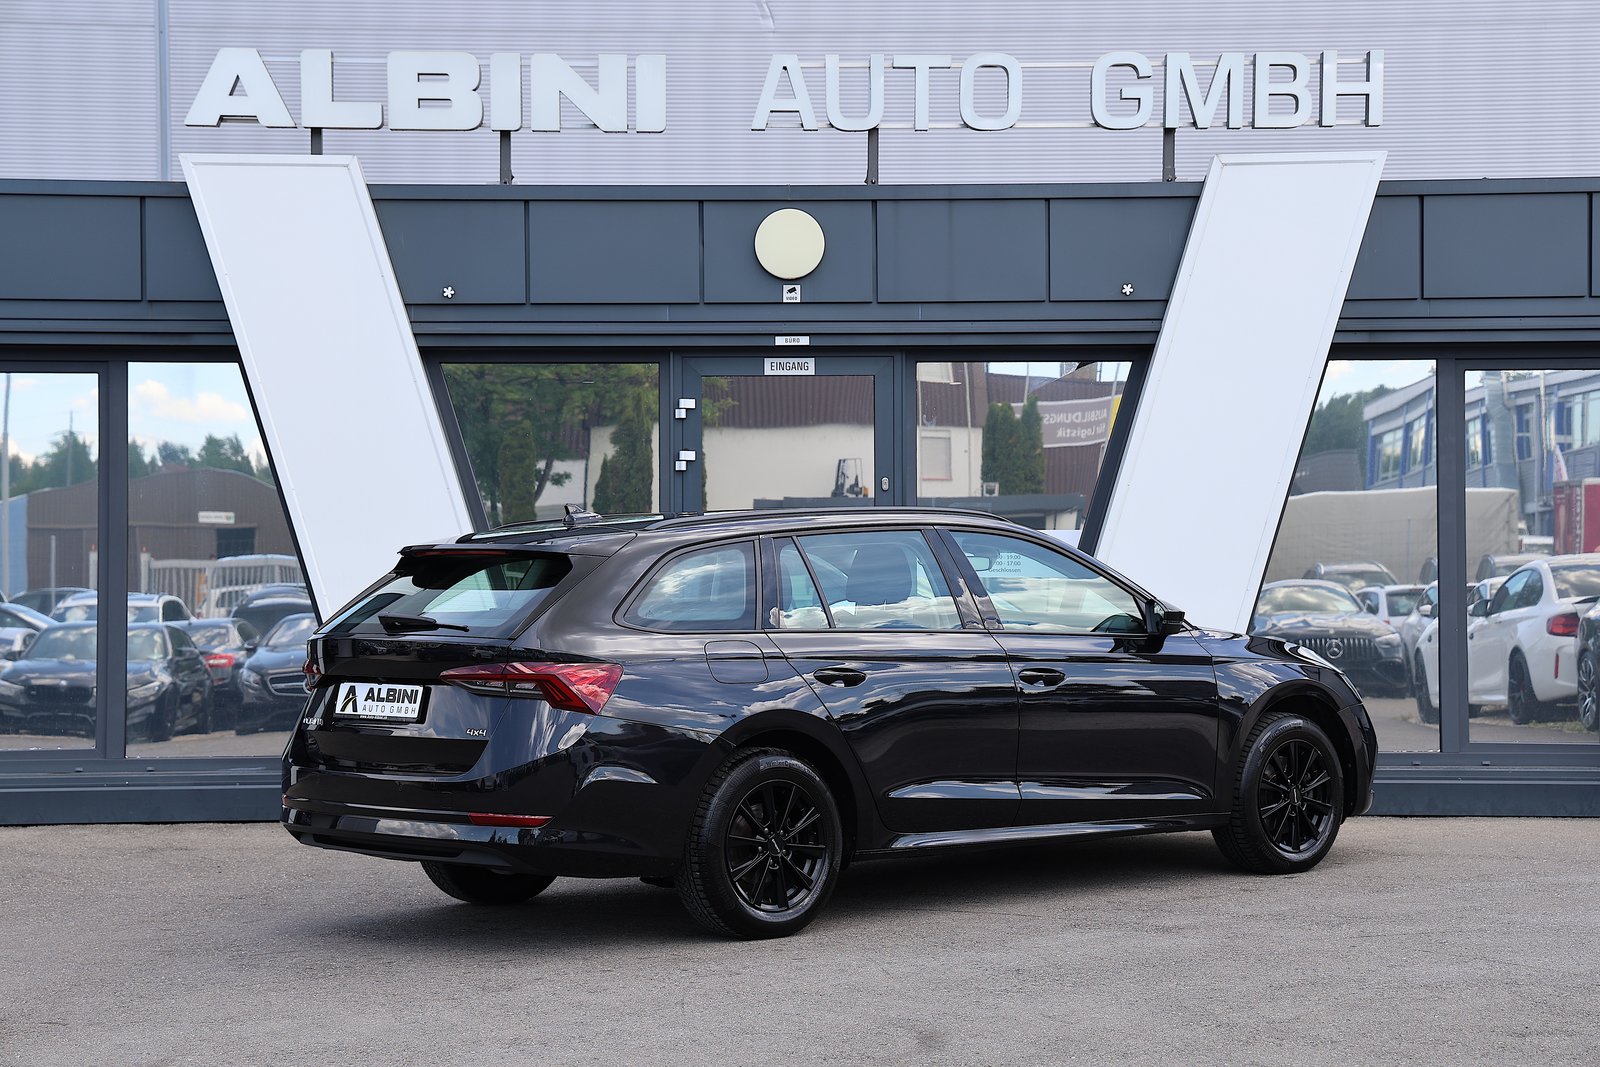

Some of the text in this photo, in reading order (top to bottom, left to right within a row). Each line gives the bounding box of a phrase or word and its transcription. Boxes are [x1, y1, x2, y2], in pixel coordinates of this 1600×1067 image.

[185, 47, 1386, 134] ALBINI AUTO GMBH
[770, 361, 809, 372] EINGANG
[364, 687, 419, 704] ALBINI
[362, 704, 416, 715] AUTO GMBH
[466, 728, 487, 737] 4x4
